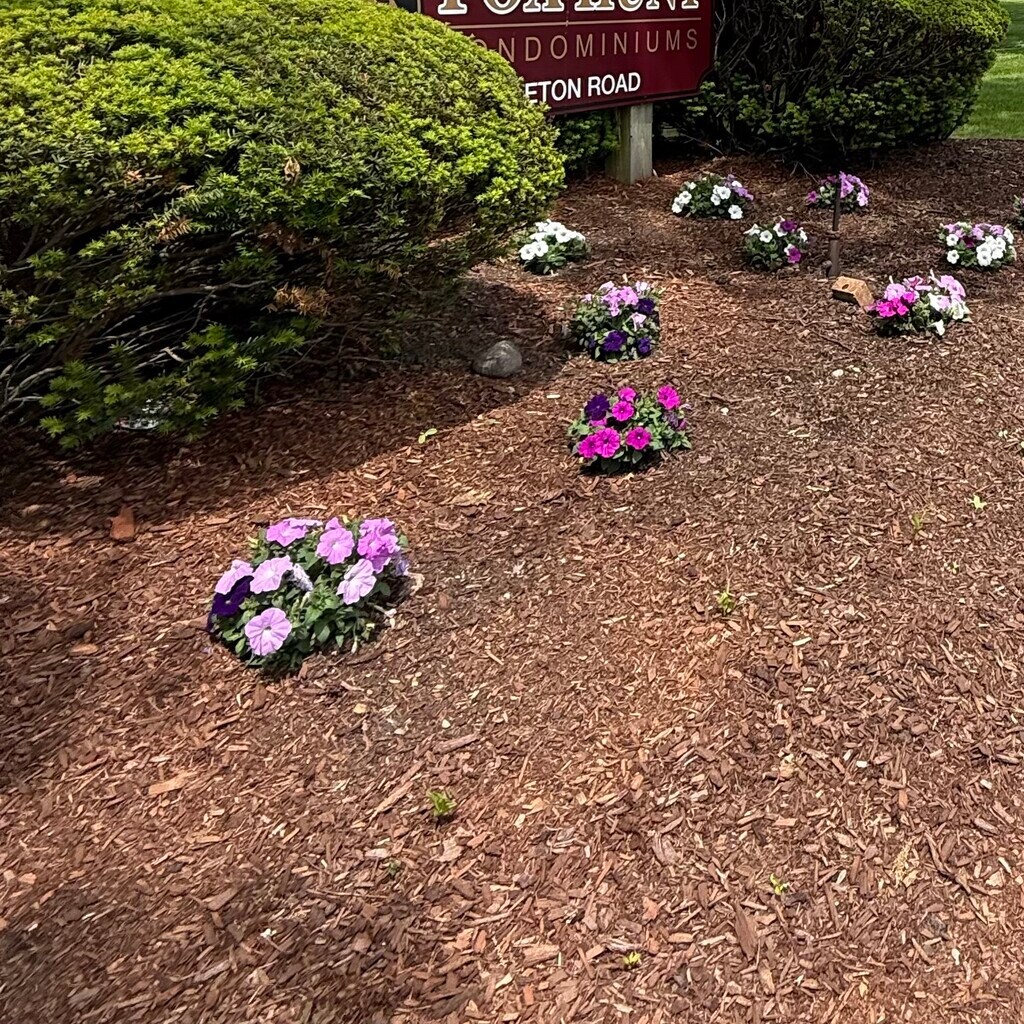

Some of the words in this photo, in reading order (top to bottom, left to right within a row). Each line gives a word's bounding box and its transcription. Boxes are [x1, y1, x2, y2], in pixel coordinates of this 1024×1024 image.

[474, 28, 698, 63] NDOMINIUMS
[525, 77, 581, 103] ETON
[587, 72, 641, 97] ROAD
